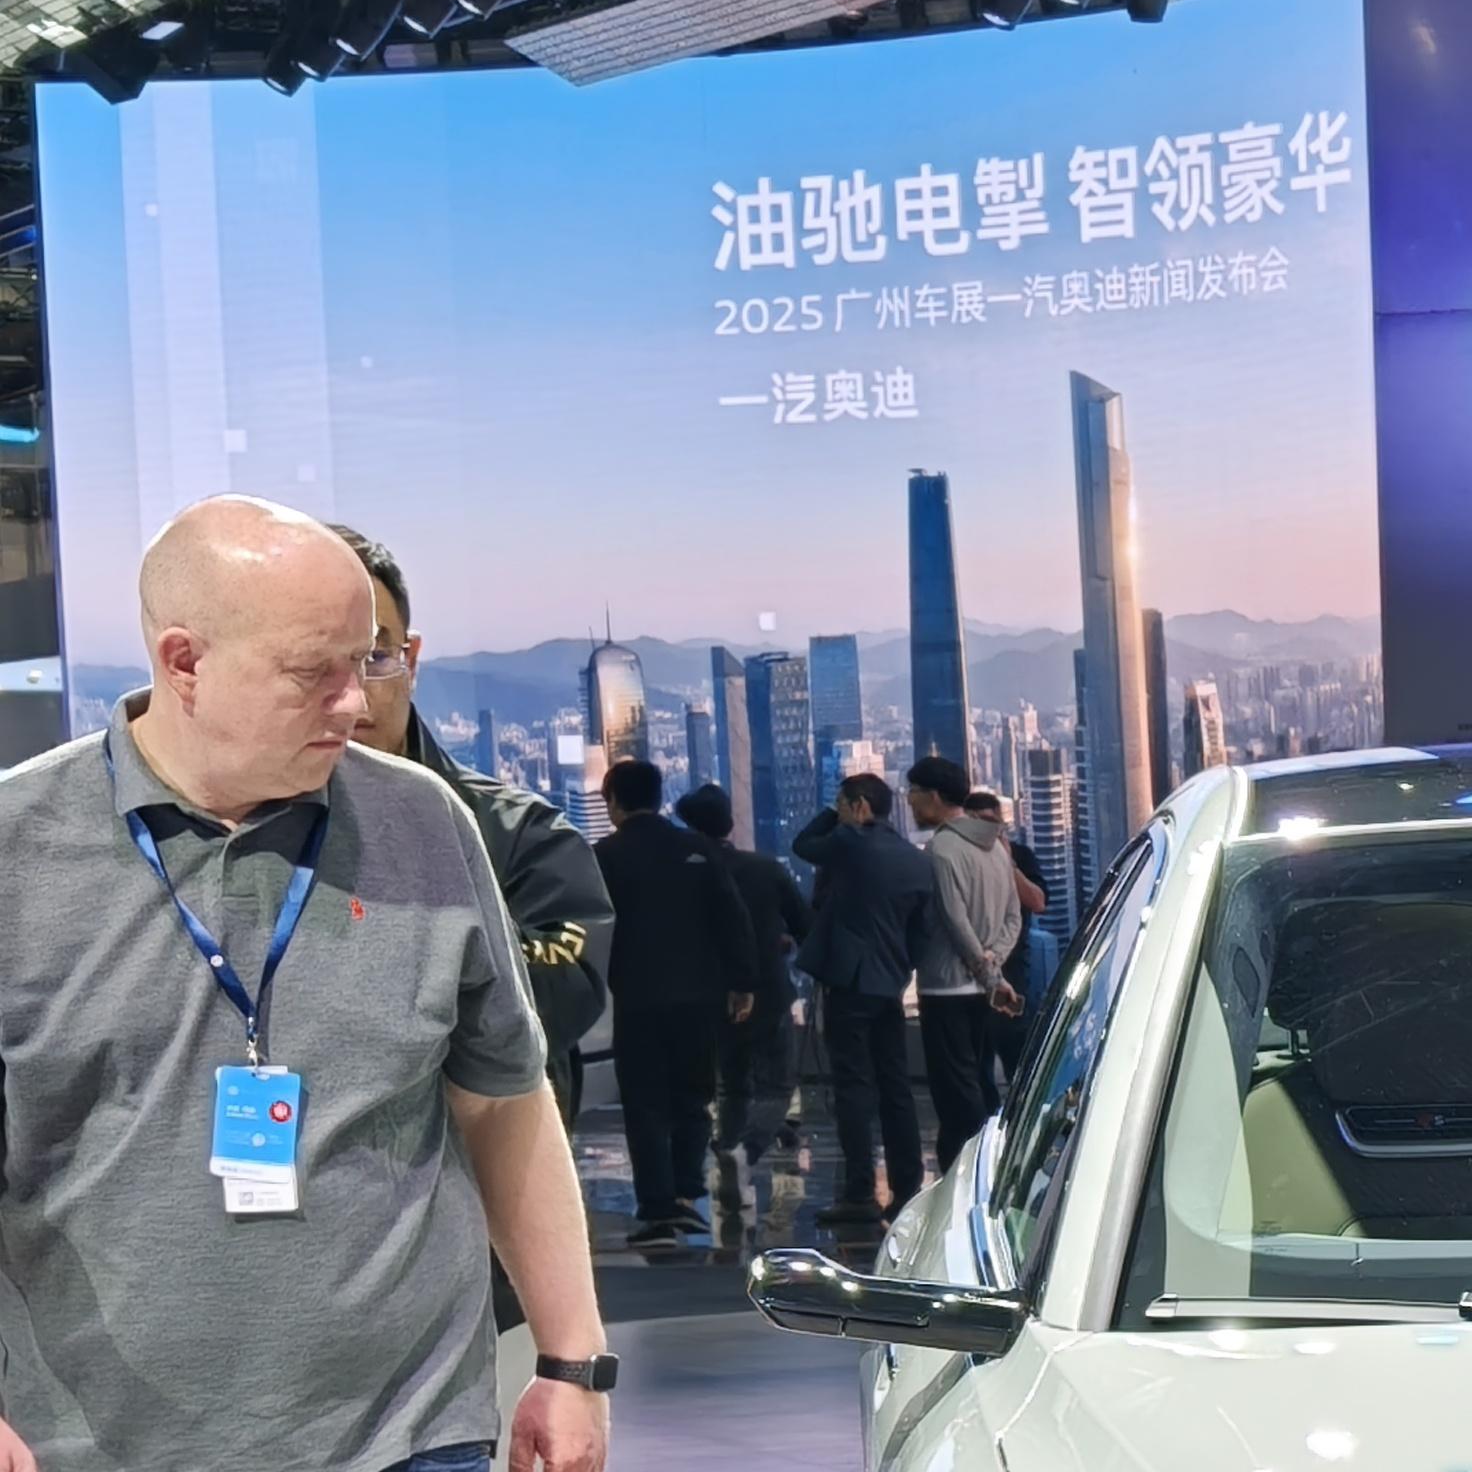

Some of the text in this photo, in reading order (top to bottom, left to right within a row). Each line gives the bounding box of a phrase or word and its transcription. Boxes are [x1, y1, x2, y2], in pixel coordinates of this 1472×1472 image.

[711, 110, 1351, 271] 油驰电掣 智领豪华
[714, 246, 1289, 335] 2025 广州车展一汽奥迪新闻发布会
[718, 365, 919, 424] 一汽奥迪
